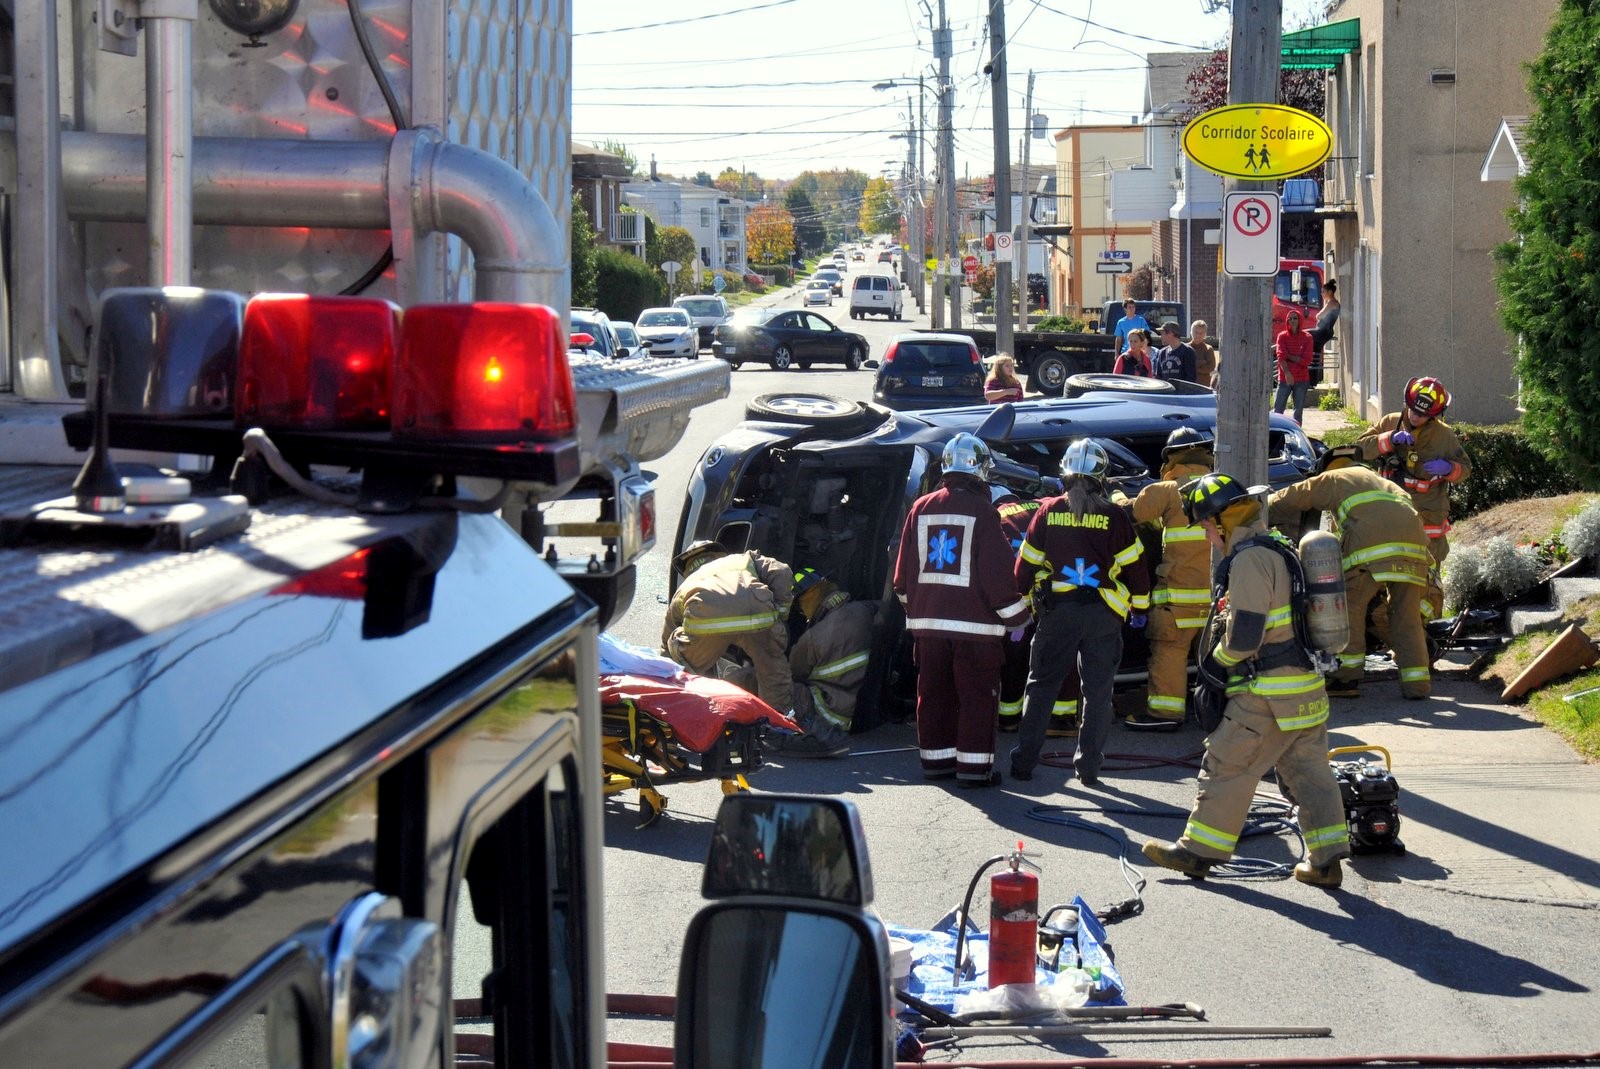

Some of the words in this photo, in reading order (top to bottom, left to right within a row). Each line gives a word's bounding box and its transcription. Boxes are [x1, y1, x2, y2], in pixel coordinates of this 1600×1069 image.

[1201, 124, 1257, 140] Corridor
[1260, 125, 1315, 141] Scolaire
[1000, 502, 1040, 519] BULANCE
